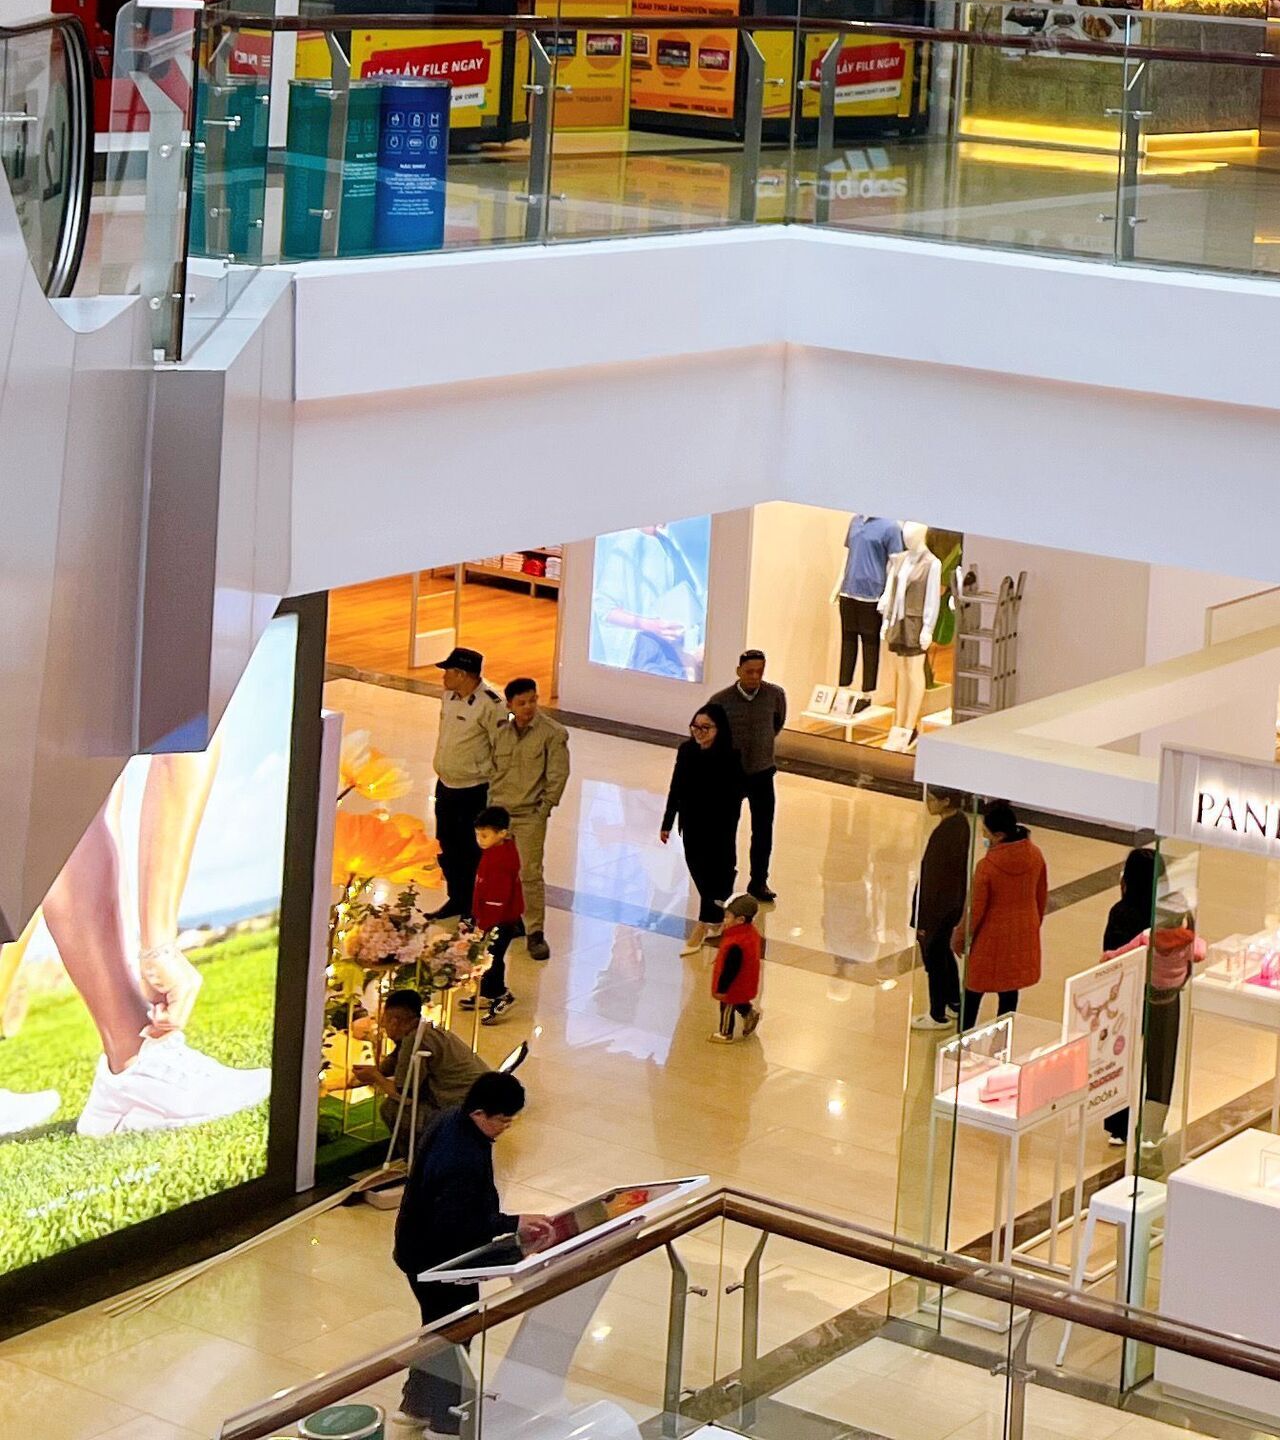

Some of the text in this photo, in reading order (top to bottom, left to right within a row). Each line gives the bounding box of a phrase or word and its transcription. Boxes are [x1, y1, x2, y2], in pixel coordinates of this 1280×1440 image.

[422, 62, 449, 76] FILE
[451, 57, 484, 72] NGAY
[855, 59, 876, 74] FILE
[876, 56, 901, 71] NGAY
